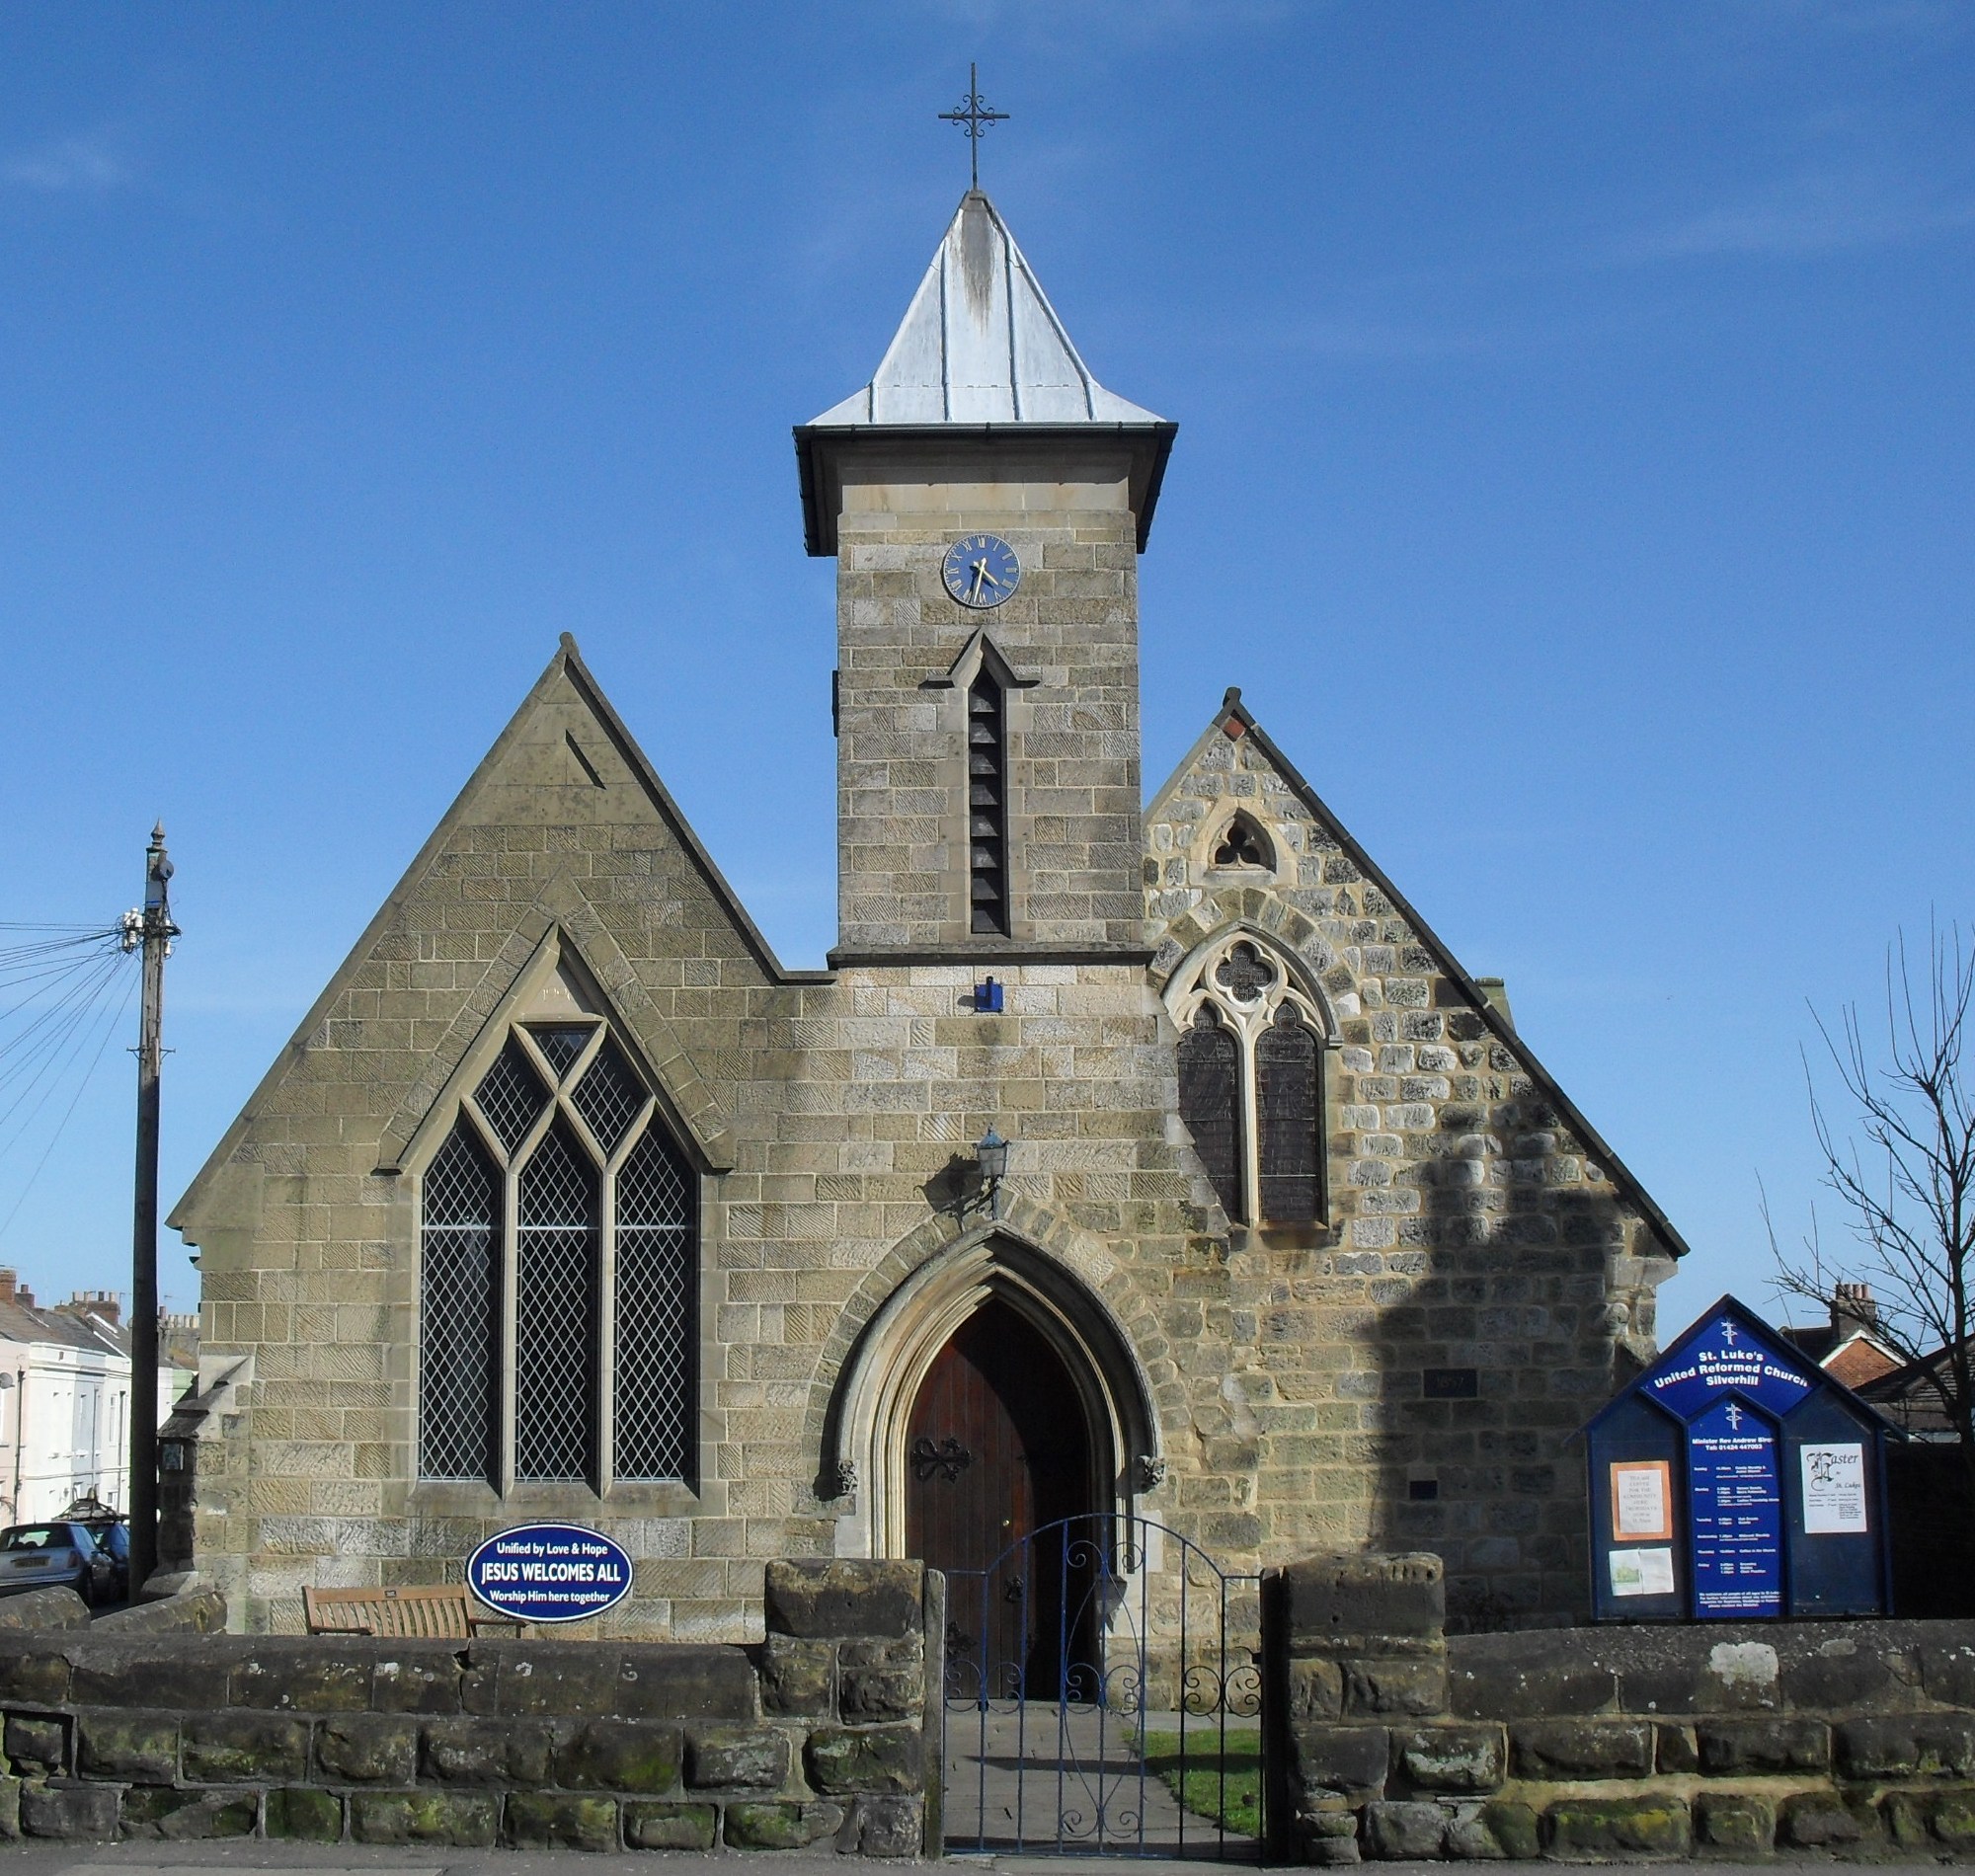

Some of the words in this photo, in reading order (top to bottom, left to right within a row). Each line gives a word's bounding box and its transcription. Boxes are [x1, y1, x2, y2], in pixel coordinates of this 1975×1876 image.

[1698, 1352, 1717, 1362] St.
[1721, 1350, 1764, 1362] Luke's
[1654, 1367, 1697, 1389] United
[1699, 1363, 1761, 1374] Reformed
[1705, 1375, 1759, 1386] Silverhill
[497, 1541, 531, 1554] Unified
[533, 1542, 544, 1557] by
[546, 1542, 569, 1555] Love
[571, 1543, 580, 1554] &
[582, 1542, 608, 1557] Hope
[481, 1562, 519, 1585] JESUS
[521, 1562, 594, 1582] WELCOMES
[596, 1563, 621, 1582] ALL
[490, 1590, 526, 1604] Worship
[527, 1590, 548, 1602] Him
[548, 1590, 570, 1602] here
[570, 1591, 610, 1605] together
